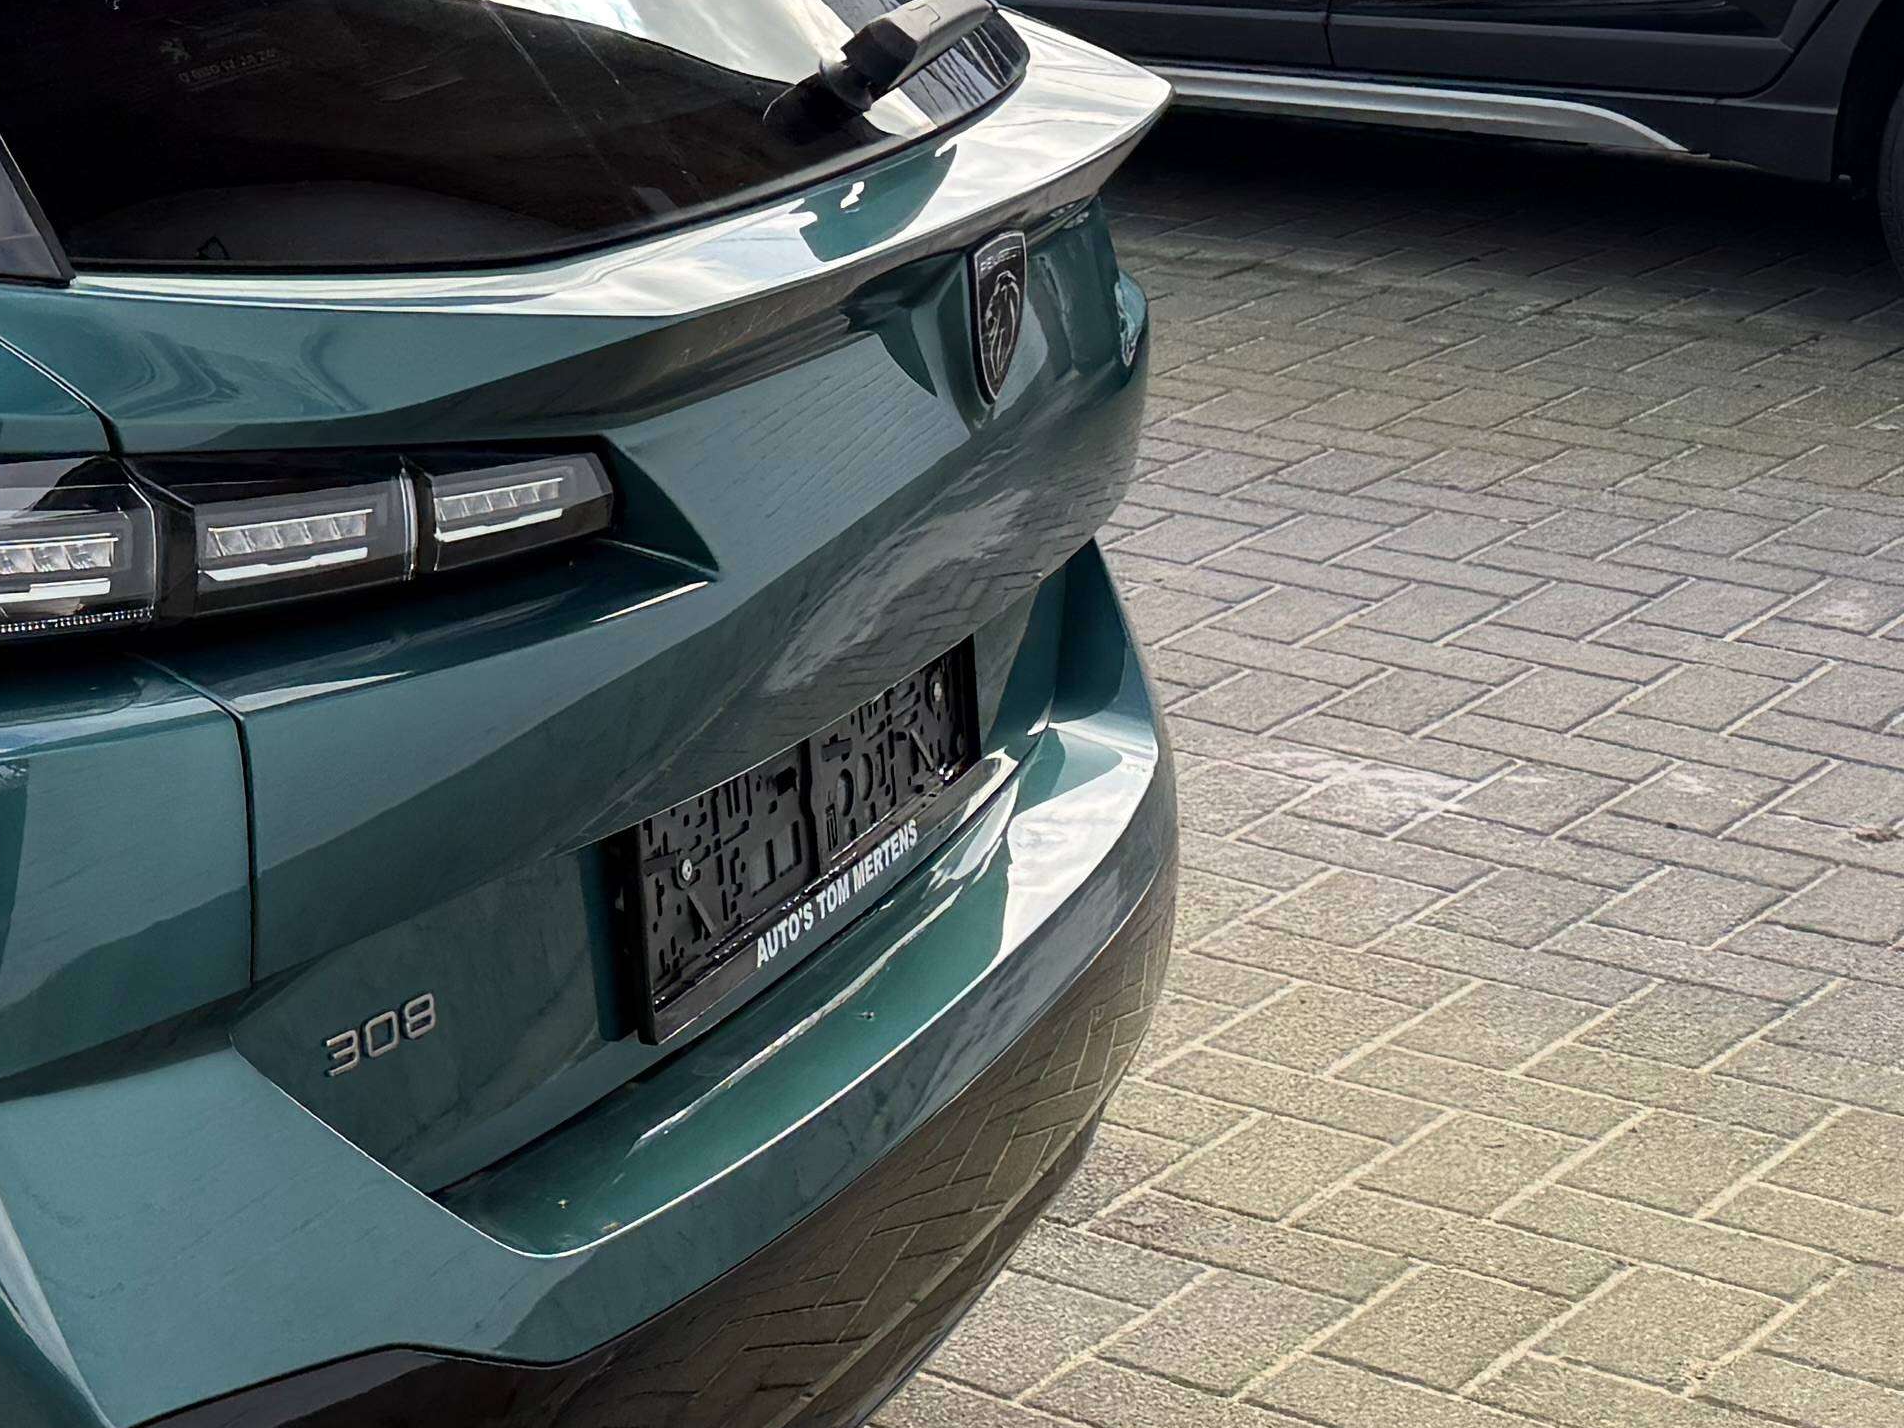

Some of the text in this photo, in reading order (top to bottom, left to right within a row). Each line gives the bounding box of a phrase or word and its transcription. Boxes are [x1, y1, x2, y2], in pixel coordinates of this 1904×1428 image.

[756, 819, 919, 969] AUTO'S TOM MERTENS
[324, 992, 436, 1077] 308
